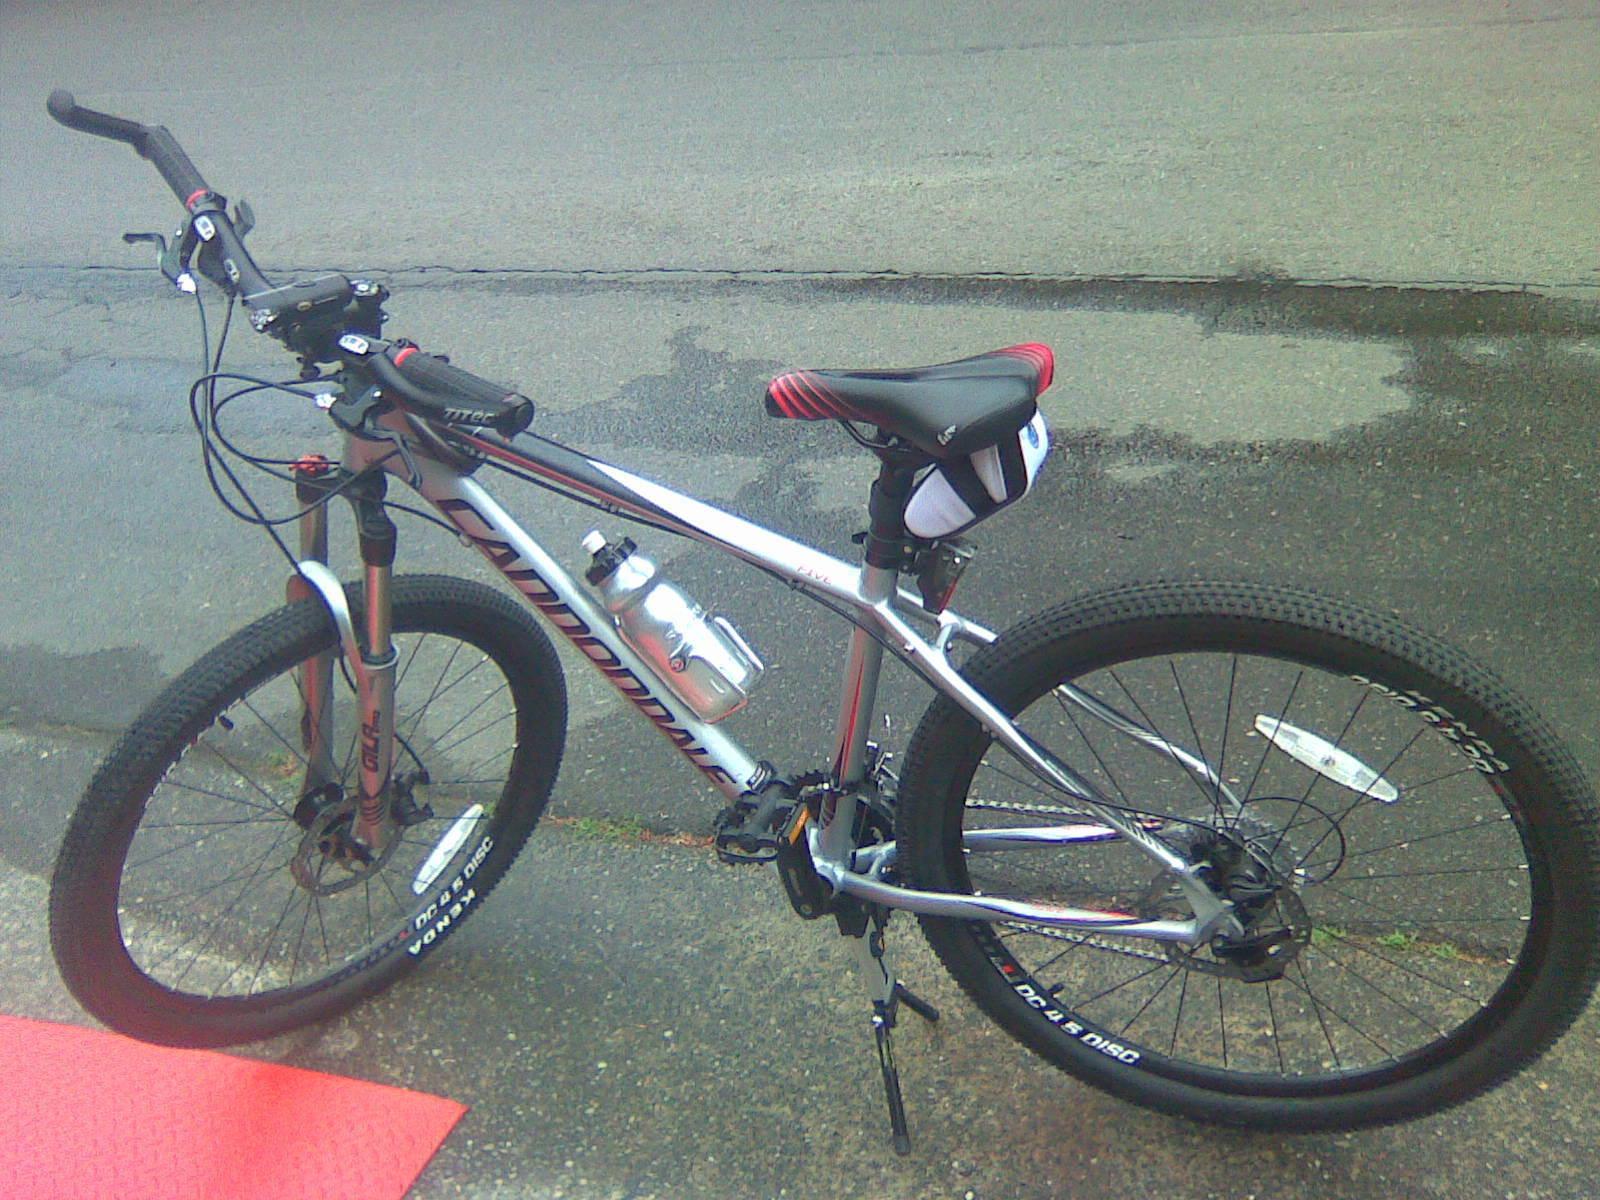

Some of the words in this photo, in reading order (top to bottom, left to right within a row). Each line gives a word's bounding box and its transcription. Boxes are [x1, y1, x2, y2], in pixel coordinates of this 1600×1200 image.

[435, 498, 738, 784] CANNONDALE
[1404, 690, 1511, 773] KENDA
[408, 887, 476, 955] KENDA
[415, 903, 438, 930] DC
[463, 836, 494, 879] DISC
[1014, 984, 1047, 1009] DC
[1080, 1032, 1141, 1064] DISC
